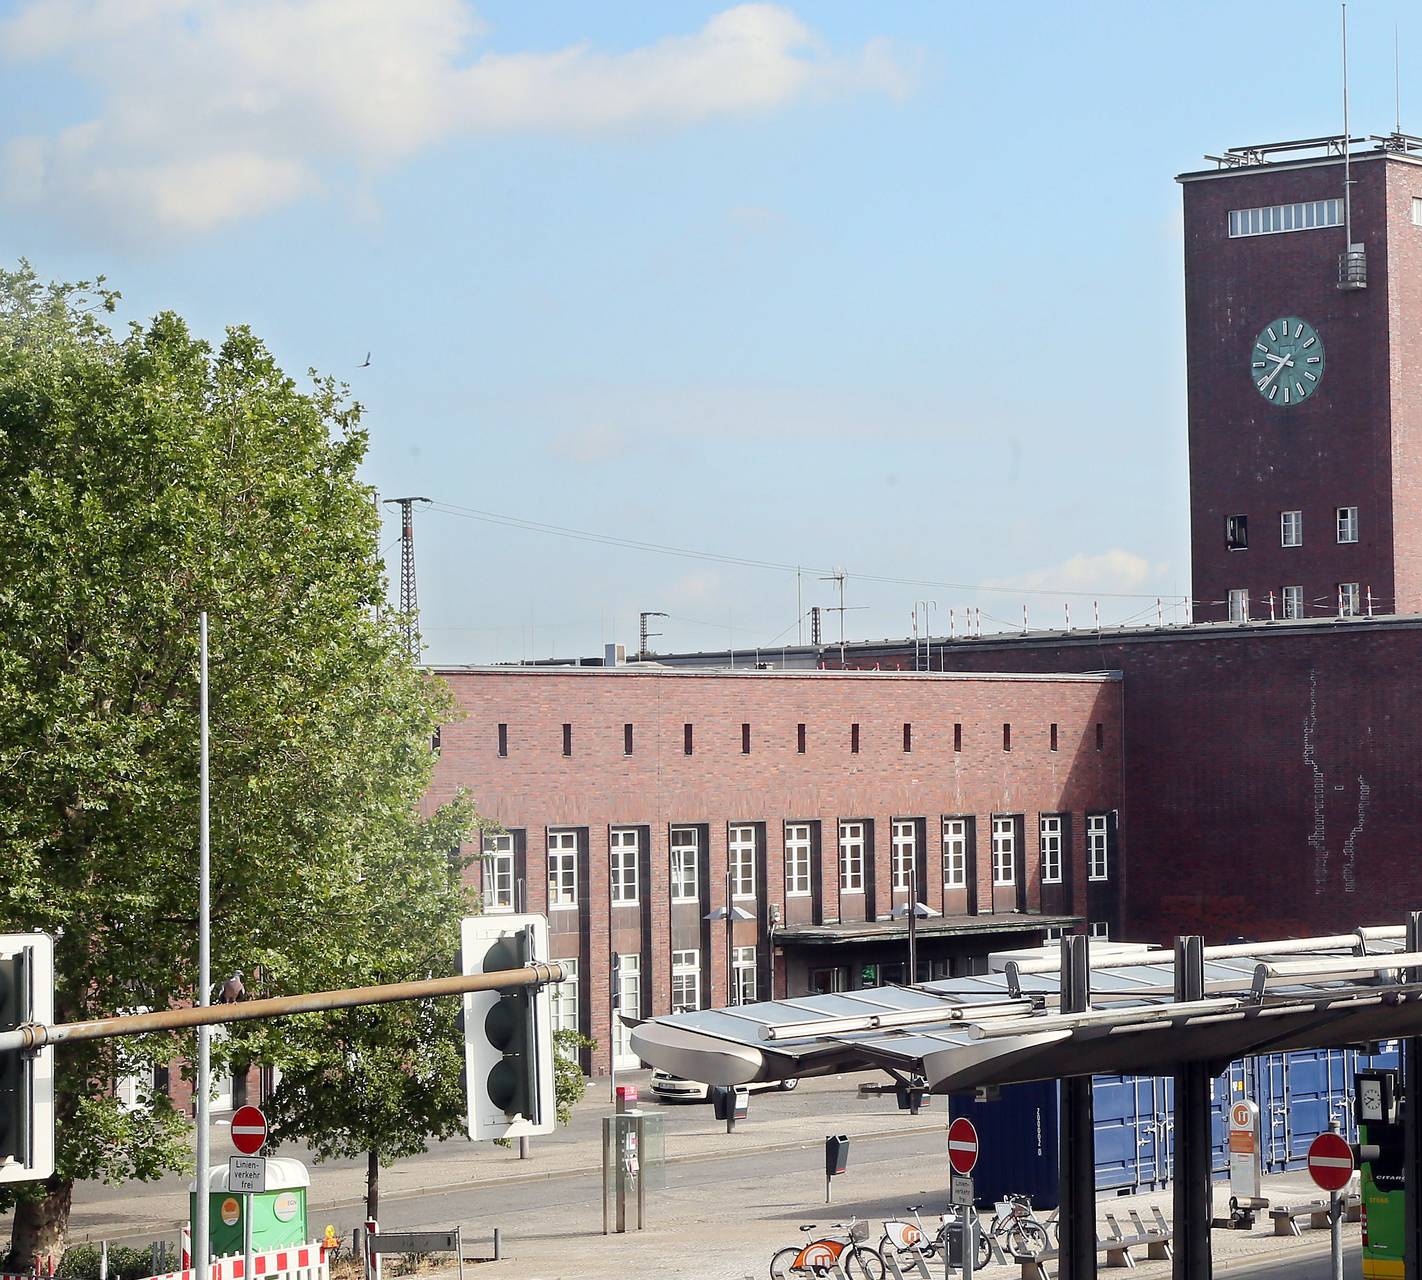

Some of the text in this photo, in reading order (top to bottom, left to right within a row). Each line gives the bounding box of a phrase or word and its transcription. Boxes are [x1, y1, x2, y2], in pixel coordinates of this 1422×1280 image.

[235, 1160, 260, 1169] Linien-
[234, 1170, 260, 1179] verkehr
[241, 1180, 254, 1189] frei
